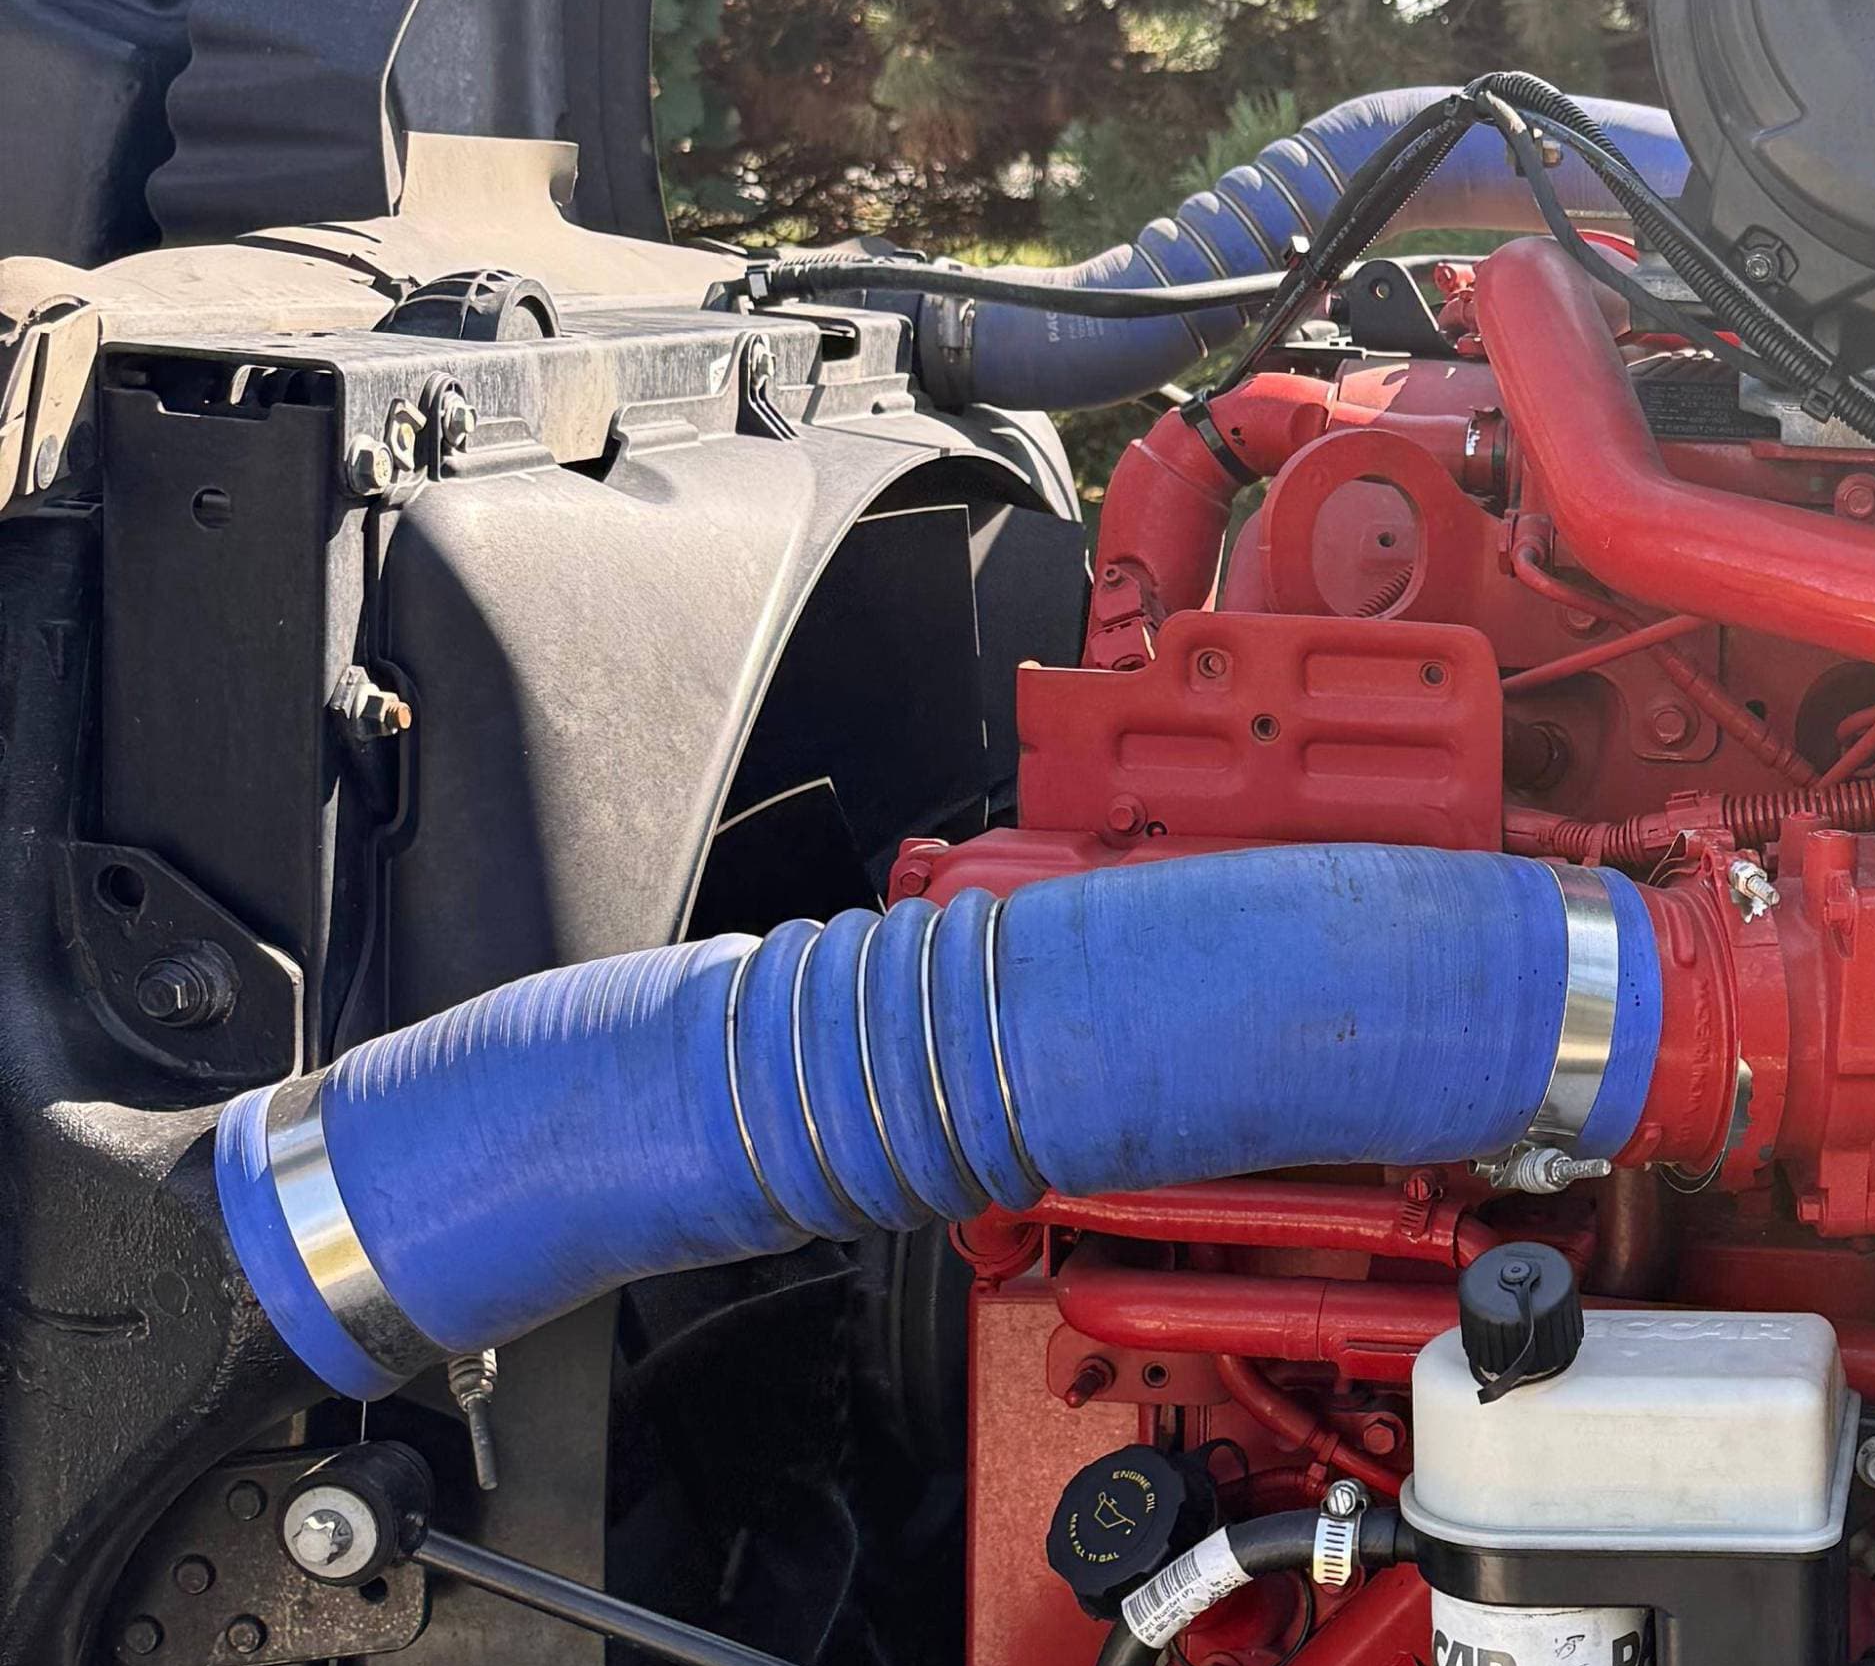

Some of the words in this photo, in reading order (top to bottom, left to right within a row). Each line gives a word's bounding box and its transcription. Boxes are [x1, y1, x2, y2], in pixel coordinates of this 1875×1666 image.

[1112, 1470, 1152, 1491] ENGINE
[1146, 1493, 1155, 1513] OIL
[1099, 1552, 1119, 1562] GAL
